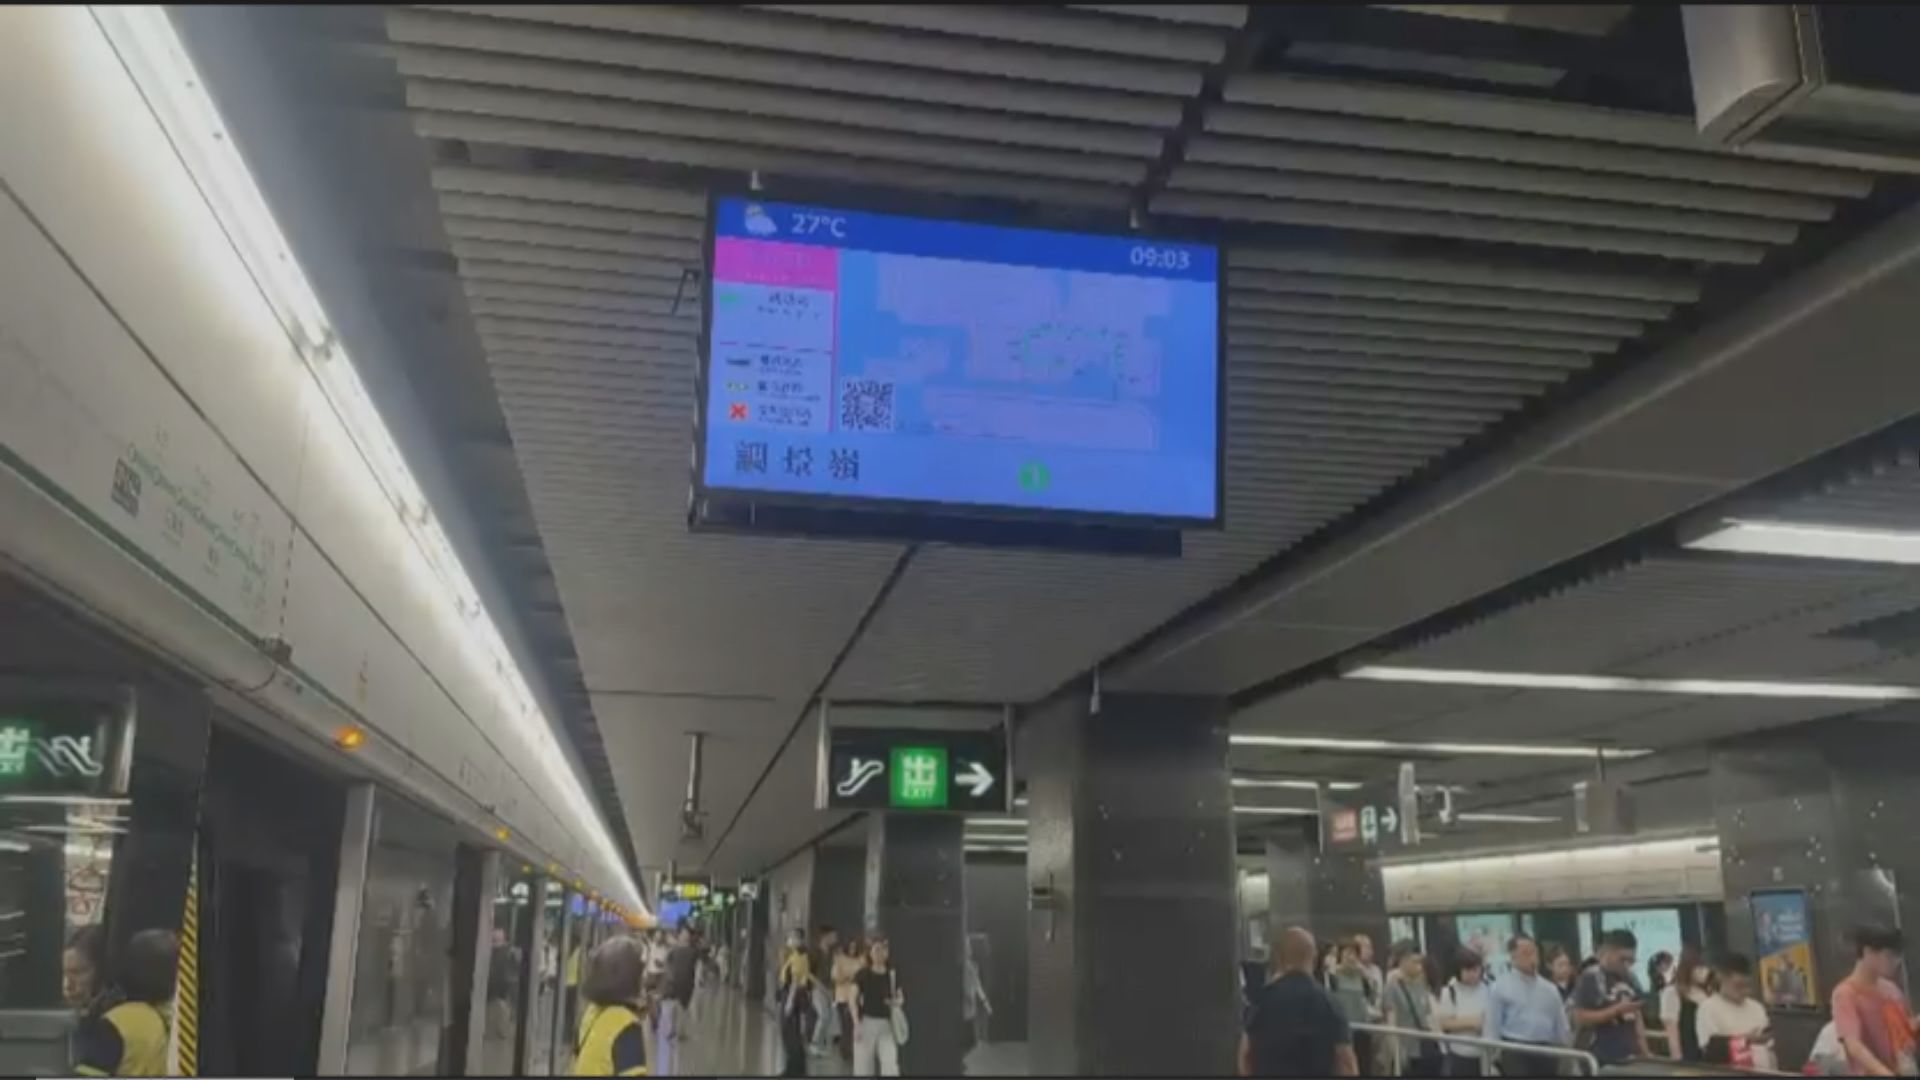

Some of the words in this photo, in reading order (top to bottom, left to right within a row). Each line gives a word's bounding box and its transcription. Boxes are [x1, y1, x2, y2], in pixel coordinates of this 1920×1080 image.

[792, 211, 846, 238] 27°C
[1130, 245, 1190, 270] 09:03
[903, 754, 937, 786] 出
[902, 786, 935, 801] EXIT
